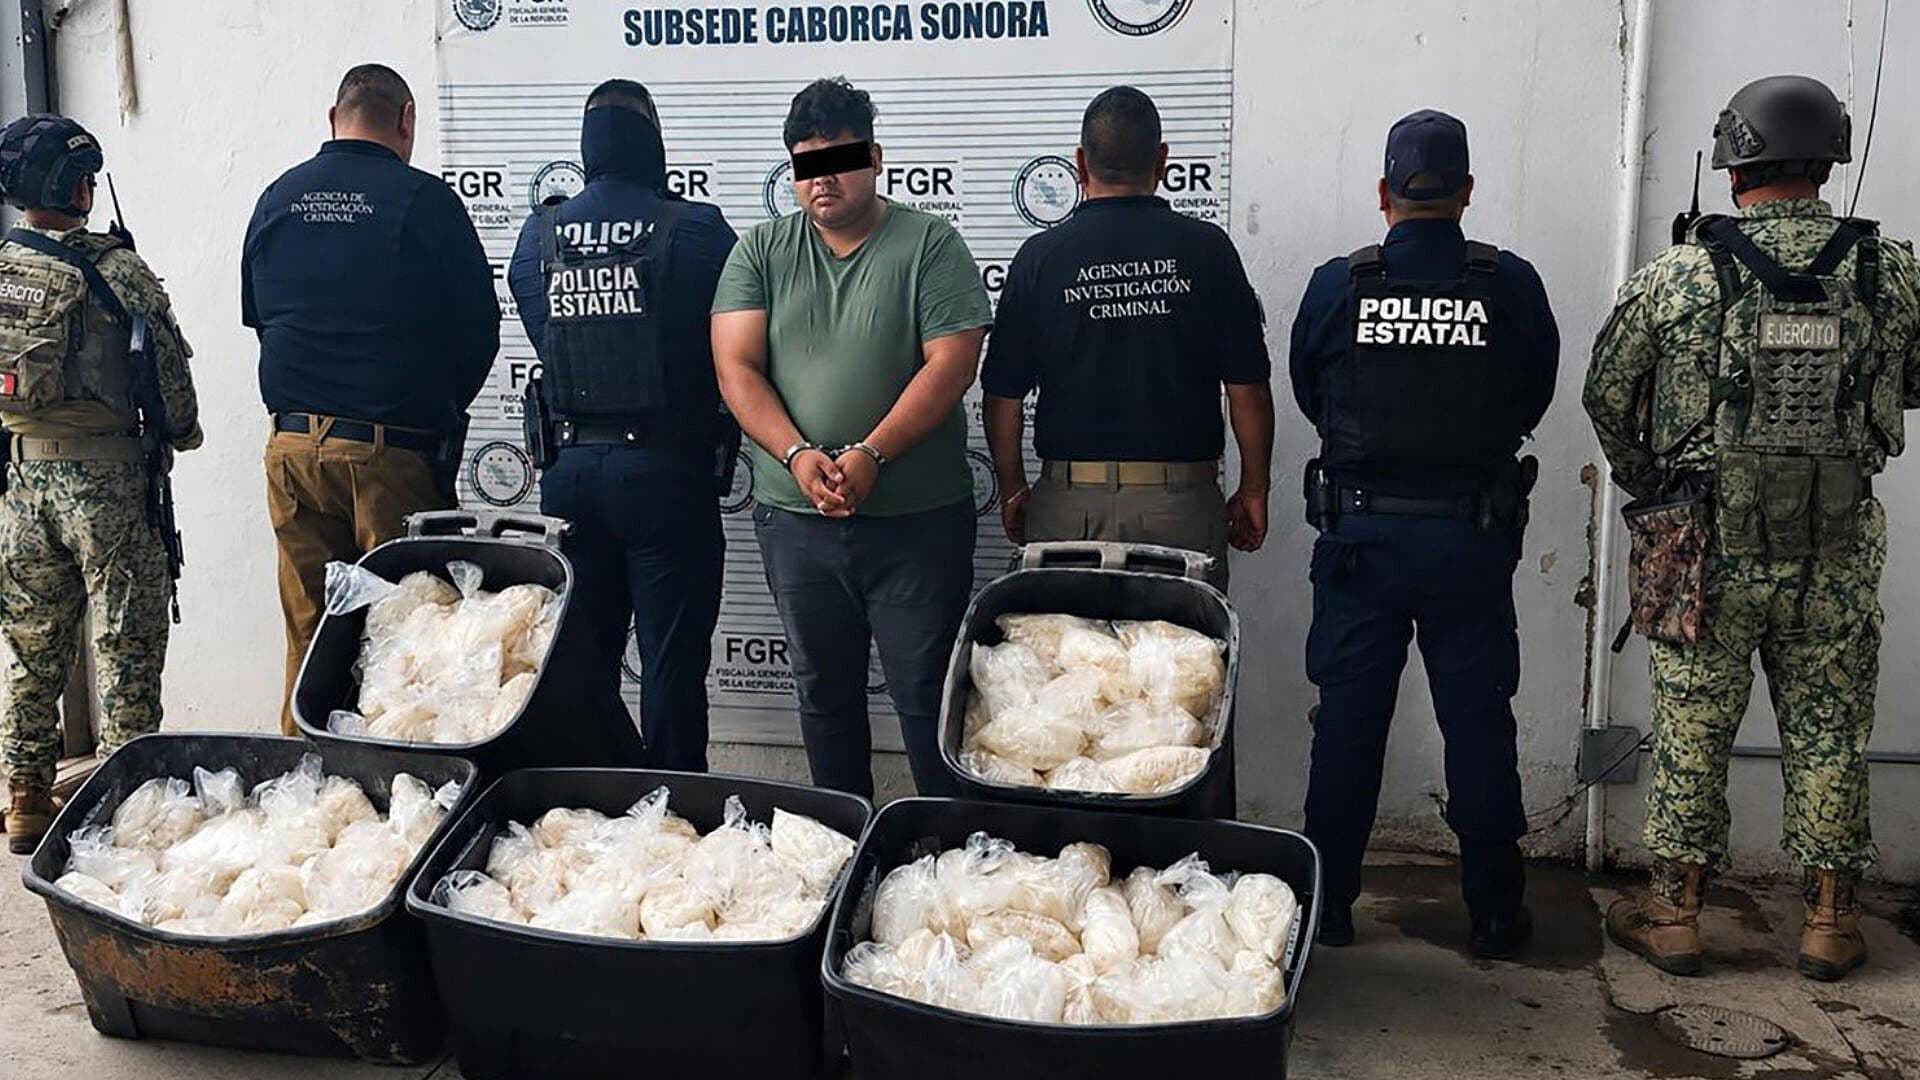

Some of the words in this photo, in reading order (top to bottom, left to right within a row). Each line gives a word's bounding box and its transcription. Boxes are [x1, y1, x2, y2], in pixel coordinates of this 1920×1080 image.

[624, 8, 757, 46] SUBSEDE
[766, 4, 912, 43] CABORCA
[920, 1, 1049, 41] SONORA
[665, 169, 711, 197] GR
[887, 167, 954, 195] FGR
[1162, 163, 1213, 192] GR
[301, 192, 348, 202] AGENCIA
[350, 193, 366, 202] DE
[303, 213, 355, 223] CRIMINAL
[1077, 261, 1151, 282] AGENCIA
[1154, 259, 1177, 274] DE
[0, 278, 44, 303] ÉRCITO
[1064, 275, 1191, 303] INVESTIGACIÓN
[549, 291, 642, 317] ESTATAL
[1089, 300, 1171, 319] CRIMINAL
[1359, 297, 1488, 323] POLICIA
[1356, 321, 1487, 346] ESTATAL
[726, 638, 789, 665] FGR
[719, 679, 730, 687] DE
[758, 670, 794, 679] GENERA
